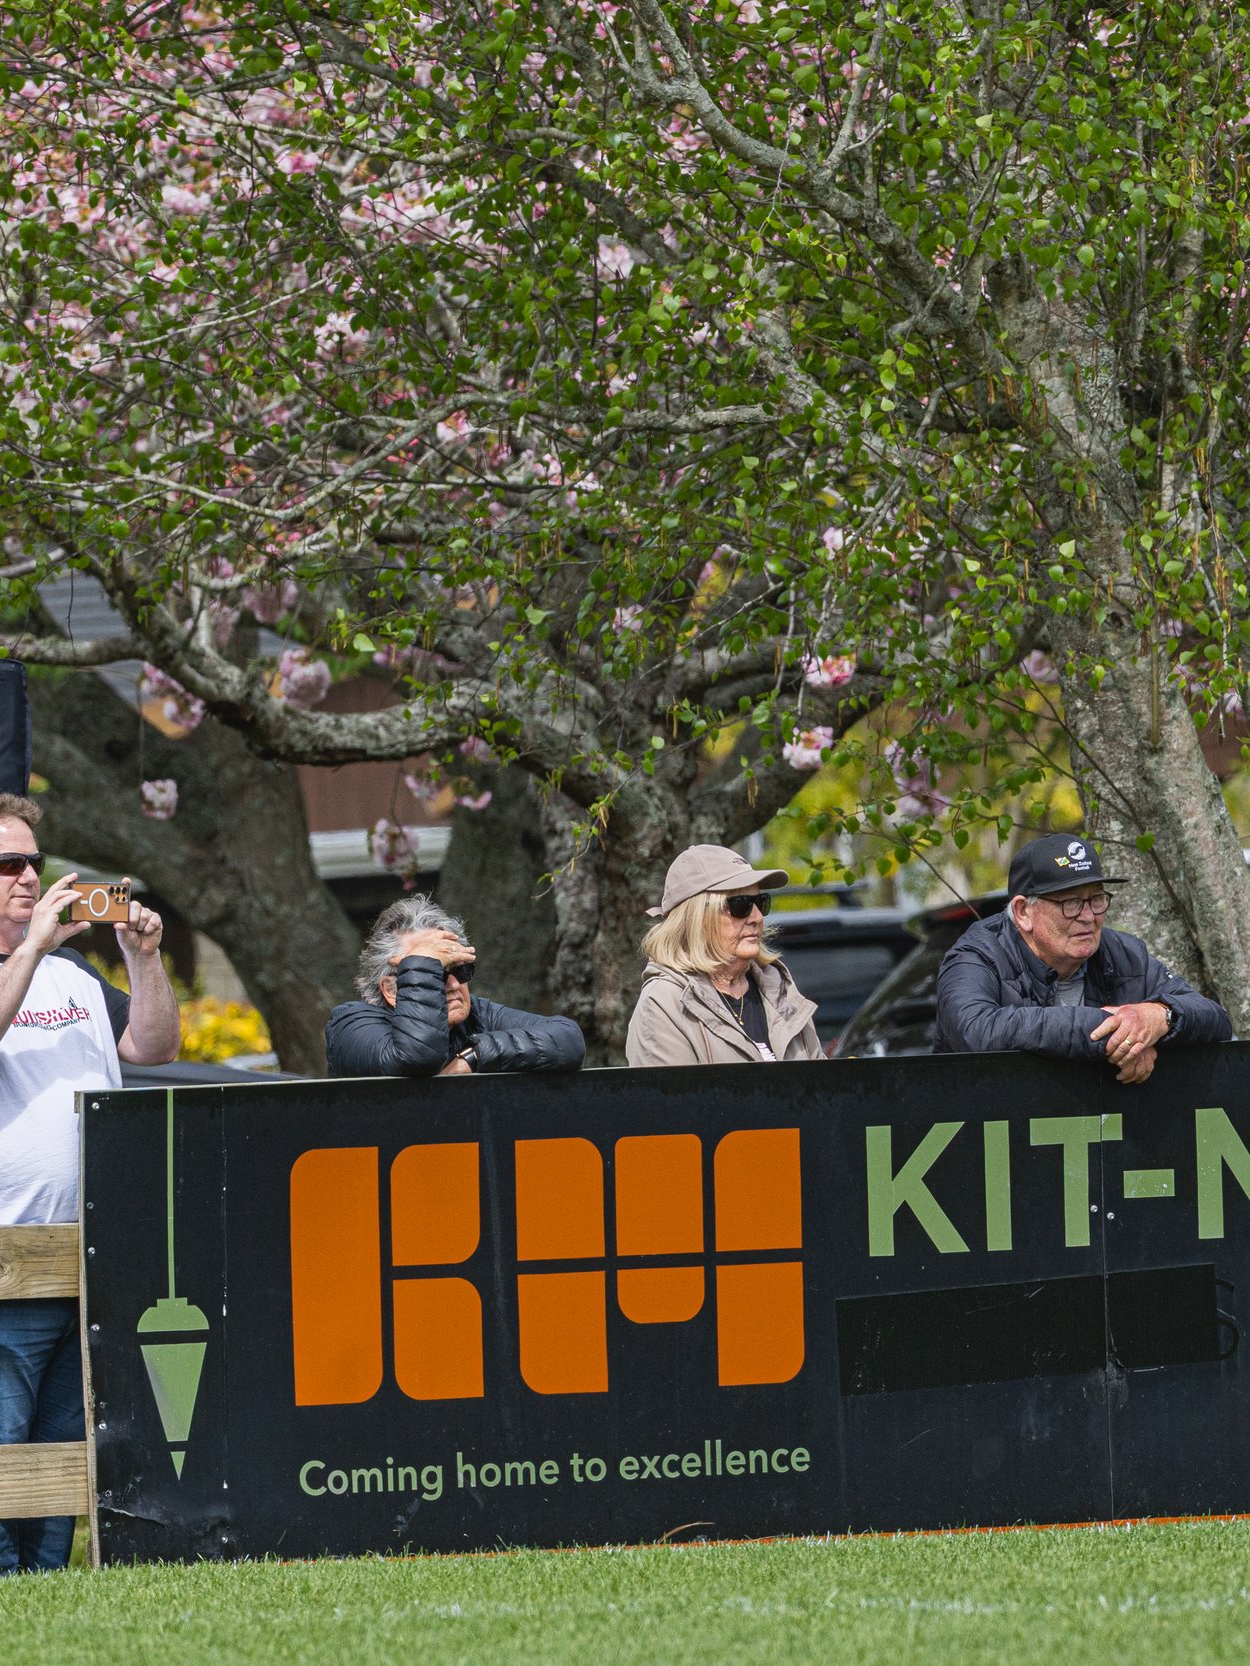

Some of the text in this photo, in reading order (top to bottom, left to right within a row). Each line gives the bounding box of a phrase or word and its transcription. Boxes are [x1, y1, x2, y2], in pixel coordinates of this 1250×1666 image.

[299, 1438, 811, 1501] Coming home to excellence
